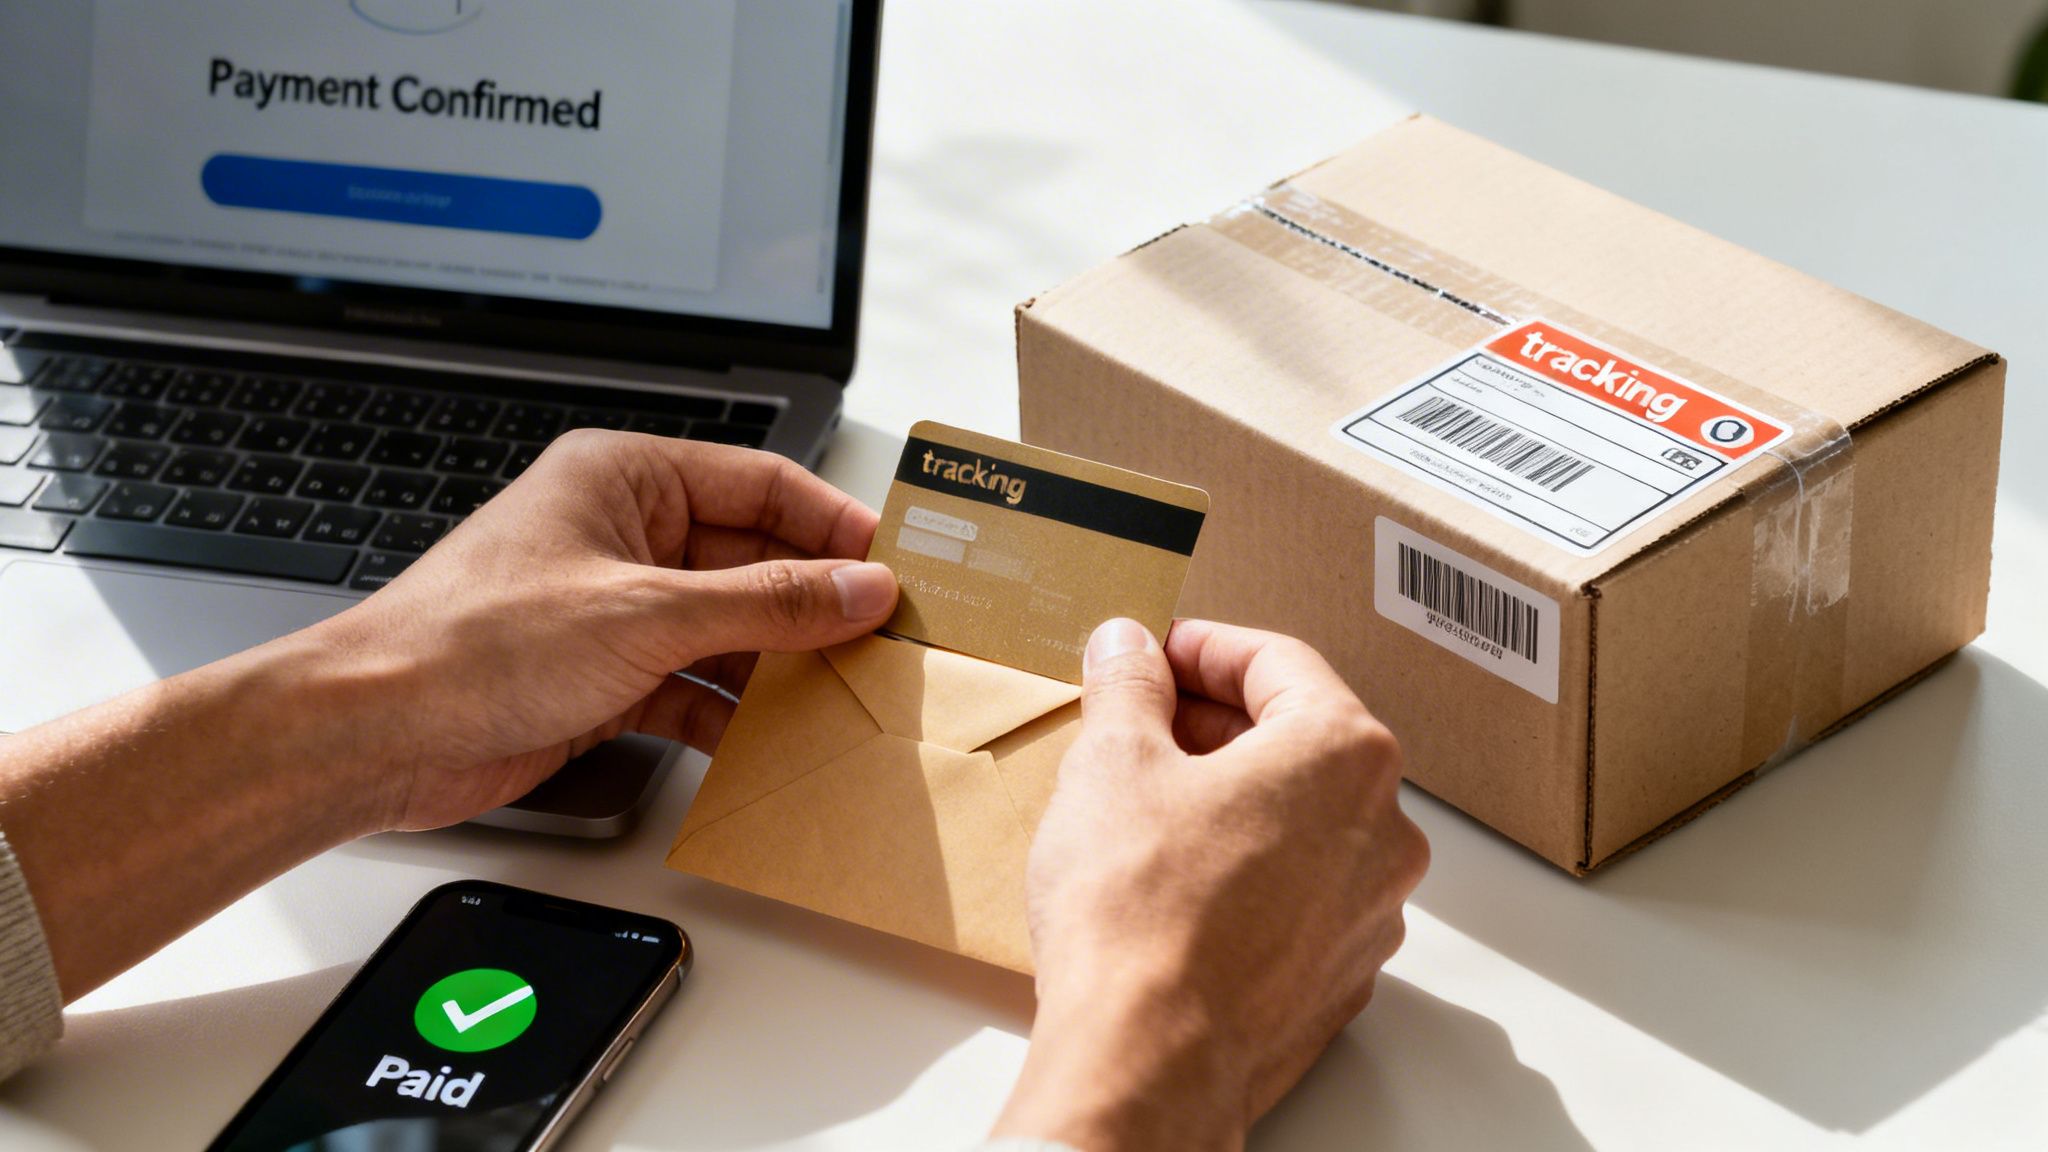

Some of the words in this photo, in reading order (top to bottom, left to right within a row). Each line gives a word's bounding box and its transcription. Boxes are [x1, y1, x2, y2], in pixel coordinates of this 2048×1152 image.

[209, 57, 380, 110] Payment
[392, 75, 602, 131] Confirmed
[1520, 331, 1688, 423] tracking
[923, 450, 1027, 505] tracking
[366, 1054, 486, 1108] Paid
